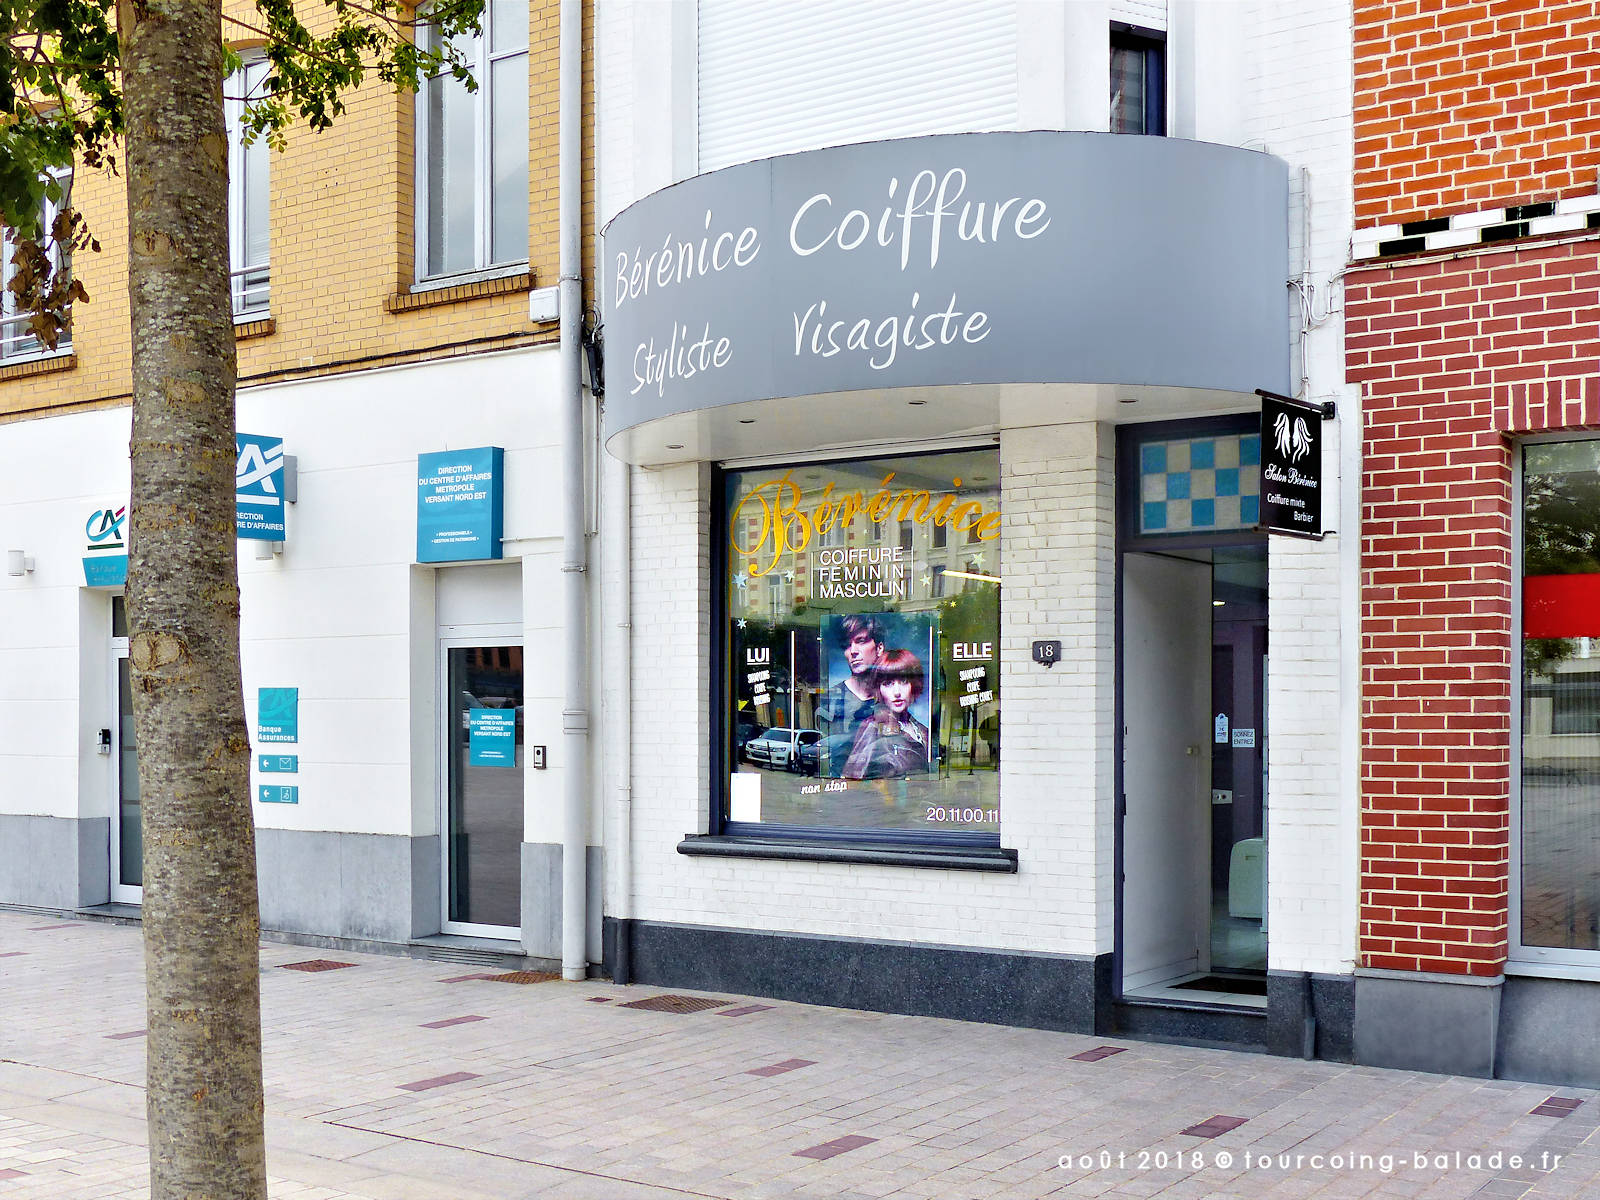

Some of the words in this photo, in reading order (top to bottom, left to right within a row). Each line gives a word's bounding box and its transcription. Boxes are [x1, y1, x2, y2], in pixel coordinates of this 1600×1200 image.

[615, 209, 761, 309] Bérénice
[789, 168, 1051, 271] Coiffure
[630, 321, 733, 399] Styliste
[793, 292, 992, 370] Visagiste
[438, 465, 472, 474] DIRECTION
[1264, 463, 1287, 482] Salon
[429, 476, 455, 484] CENTRE
[455, 472, 492, 482] D'AFFAIRES
[435, 484, 475, 493] METROPOLE
[425, 494, 454, 503] VERSANT
[455, 492, 473, 501] NORD
[474, 491, 487, 499] EST
[1267, 493, 1289, 505] Coiffure
[1290, 498, 1305, 508] mixte
[730, 469, 1001, 577] Bérénice
[1293, 510, 1314, 522] Barbier
[247, 521, 284, 530] D'AFFAIRES
[819, 547, 904, 566] COIFFURE
[819, 563, 904, 582] FEMININ
[819, 581, 904, 598] MASCULIN
[746, 647, 770, 663] LUI
[953, 642, 992, 659] ELLE
[1039, 645, 1054, 658] 18
[258, 725, 282, 734] Banque
[258, 733, 295, 741] Assurances
[801, 784, 820, 795] non
[824, 780, 848, 793] stop
[926, 807, 999, 823] 20.11.00.11
